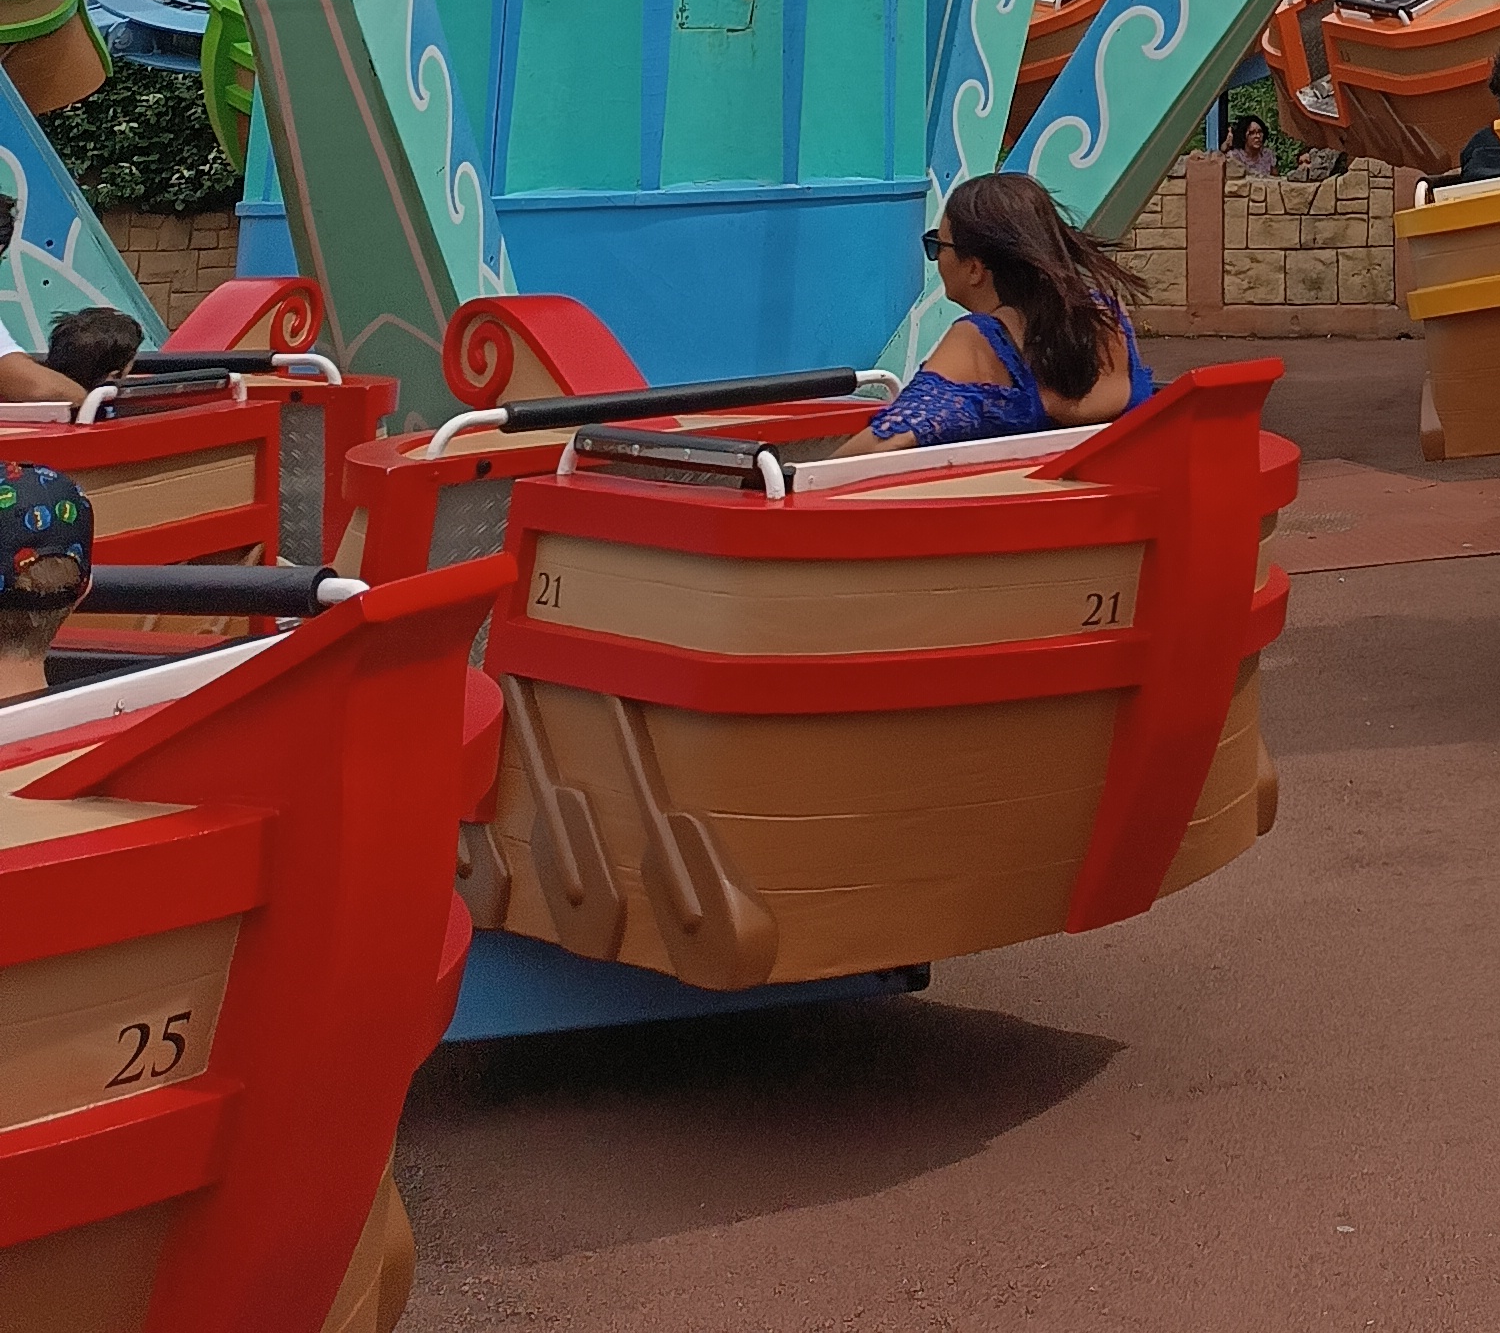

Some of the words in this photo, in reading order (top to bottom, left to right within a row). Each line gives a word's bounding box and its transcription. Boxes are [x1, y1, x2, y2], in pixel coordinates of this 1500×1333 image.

[535, 572, 562, 609] 21
[1081, 591, 1120, 626] 21
[103, 1009, 192, 1090] 25
